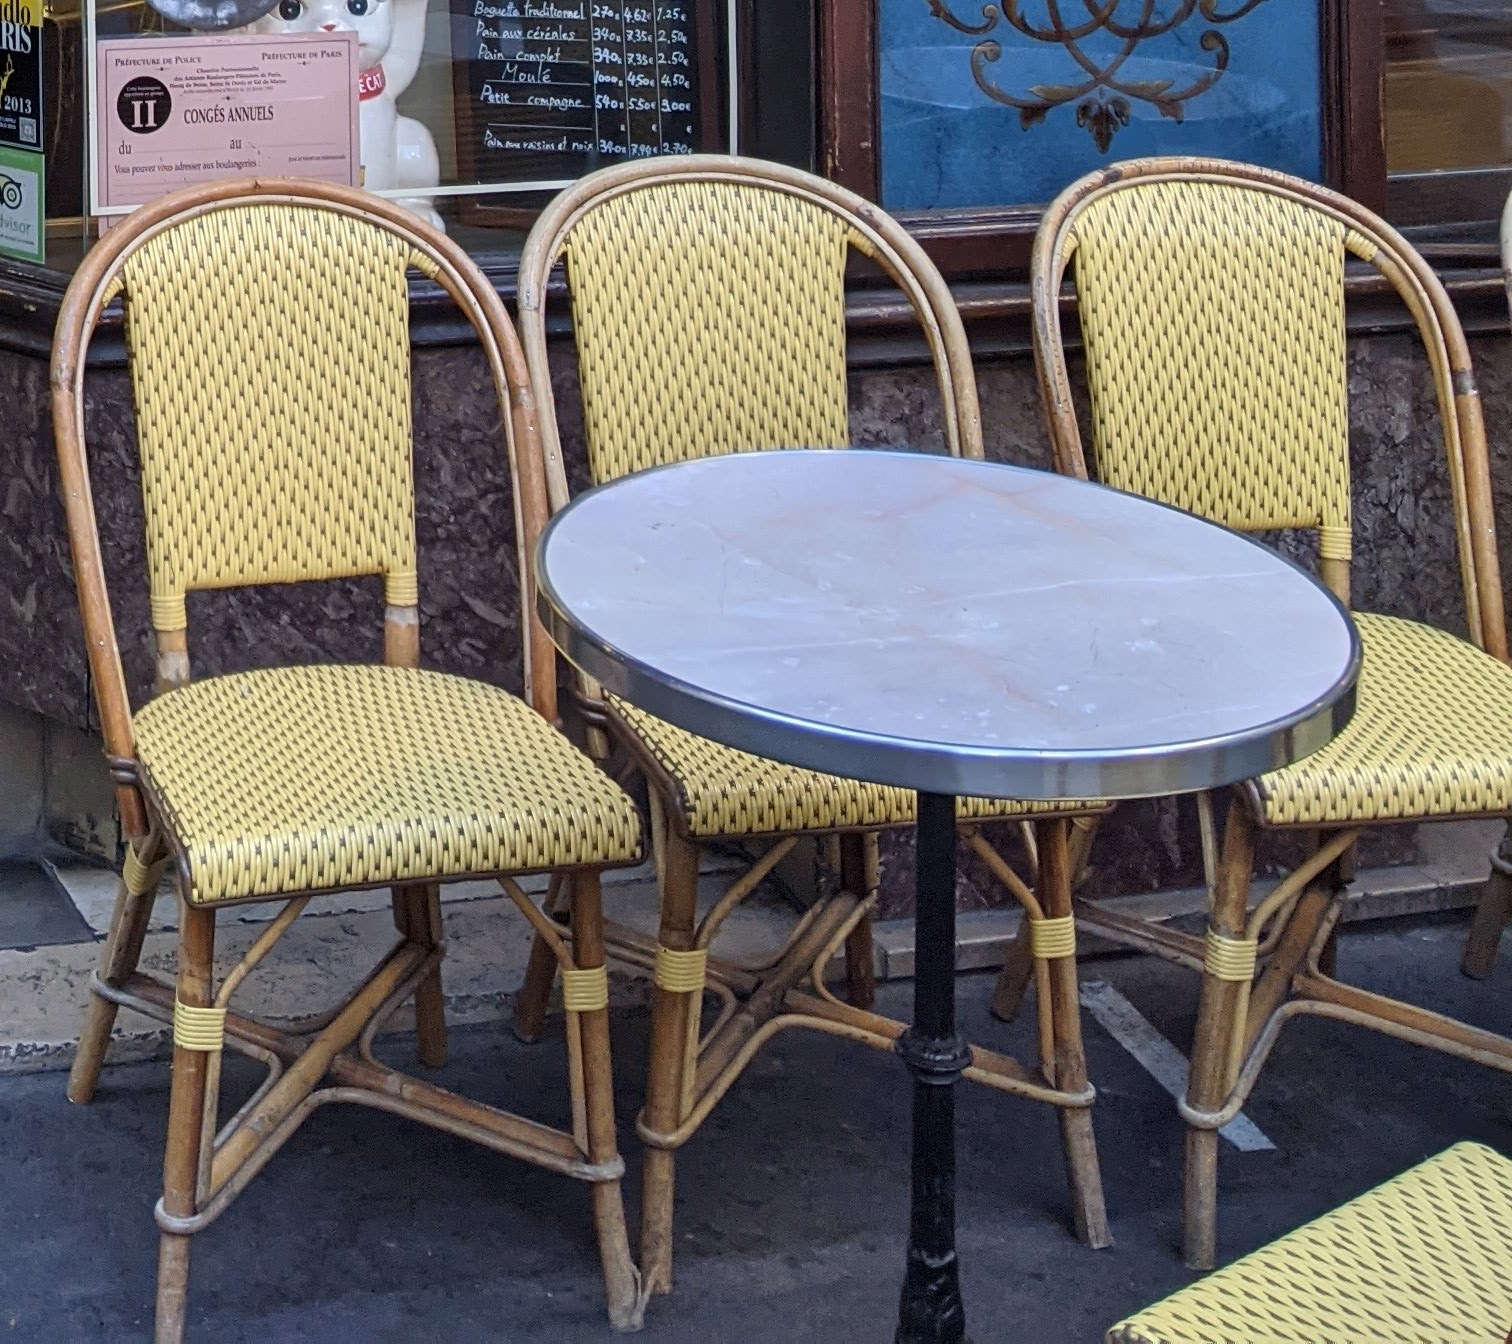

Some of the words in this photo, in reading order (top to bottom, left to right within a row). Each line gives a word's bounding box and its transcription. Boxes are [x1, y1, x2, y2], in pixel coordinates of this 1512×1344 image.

[476, 18, 499, 37] Pain
[502, 29, 523, 39] aux
[526, 24, 576, 40] céréales
[478, 43, 505, 60] Pain
[515, 46, 561, 63] complet
[366, 73, 383, 90] CAT
[480, 83, 510, 104] Petit
[4, 95, 32, 114] 2013
[131, 99, 158, 128] II
[184, 104, 225, 125] CONGÉS
[228, 105, 274, 123] ANNUELS
[118, 140, 132, 155] du
[229, 139, 242, 150] au
[114, 164, 131, 174] Vous
[131, 163, 156, 176] pouvez
[157, 163, 173, 173] vous
[174, 160, 202, 172] adresser
[202, 161, 215, 170] aux
[215, 159, 257, 172] boulangeries
